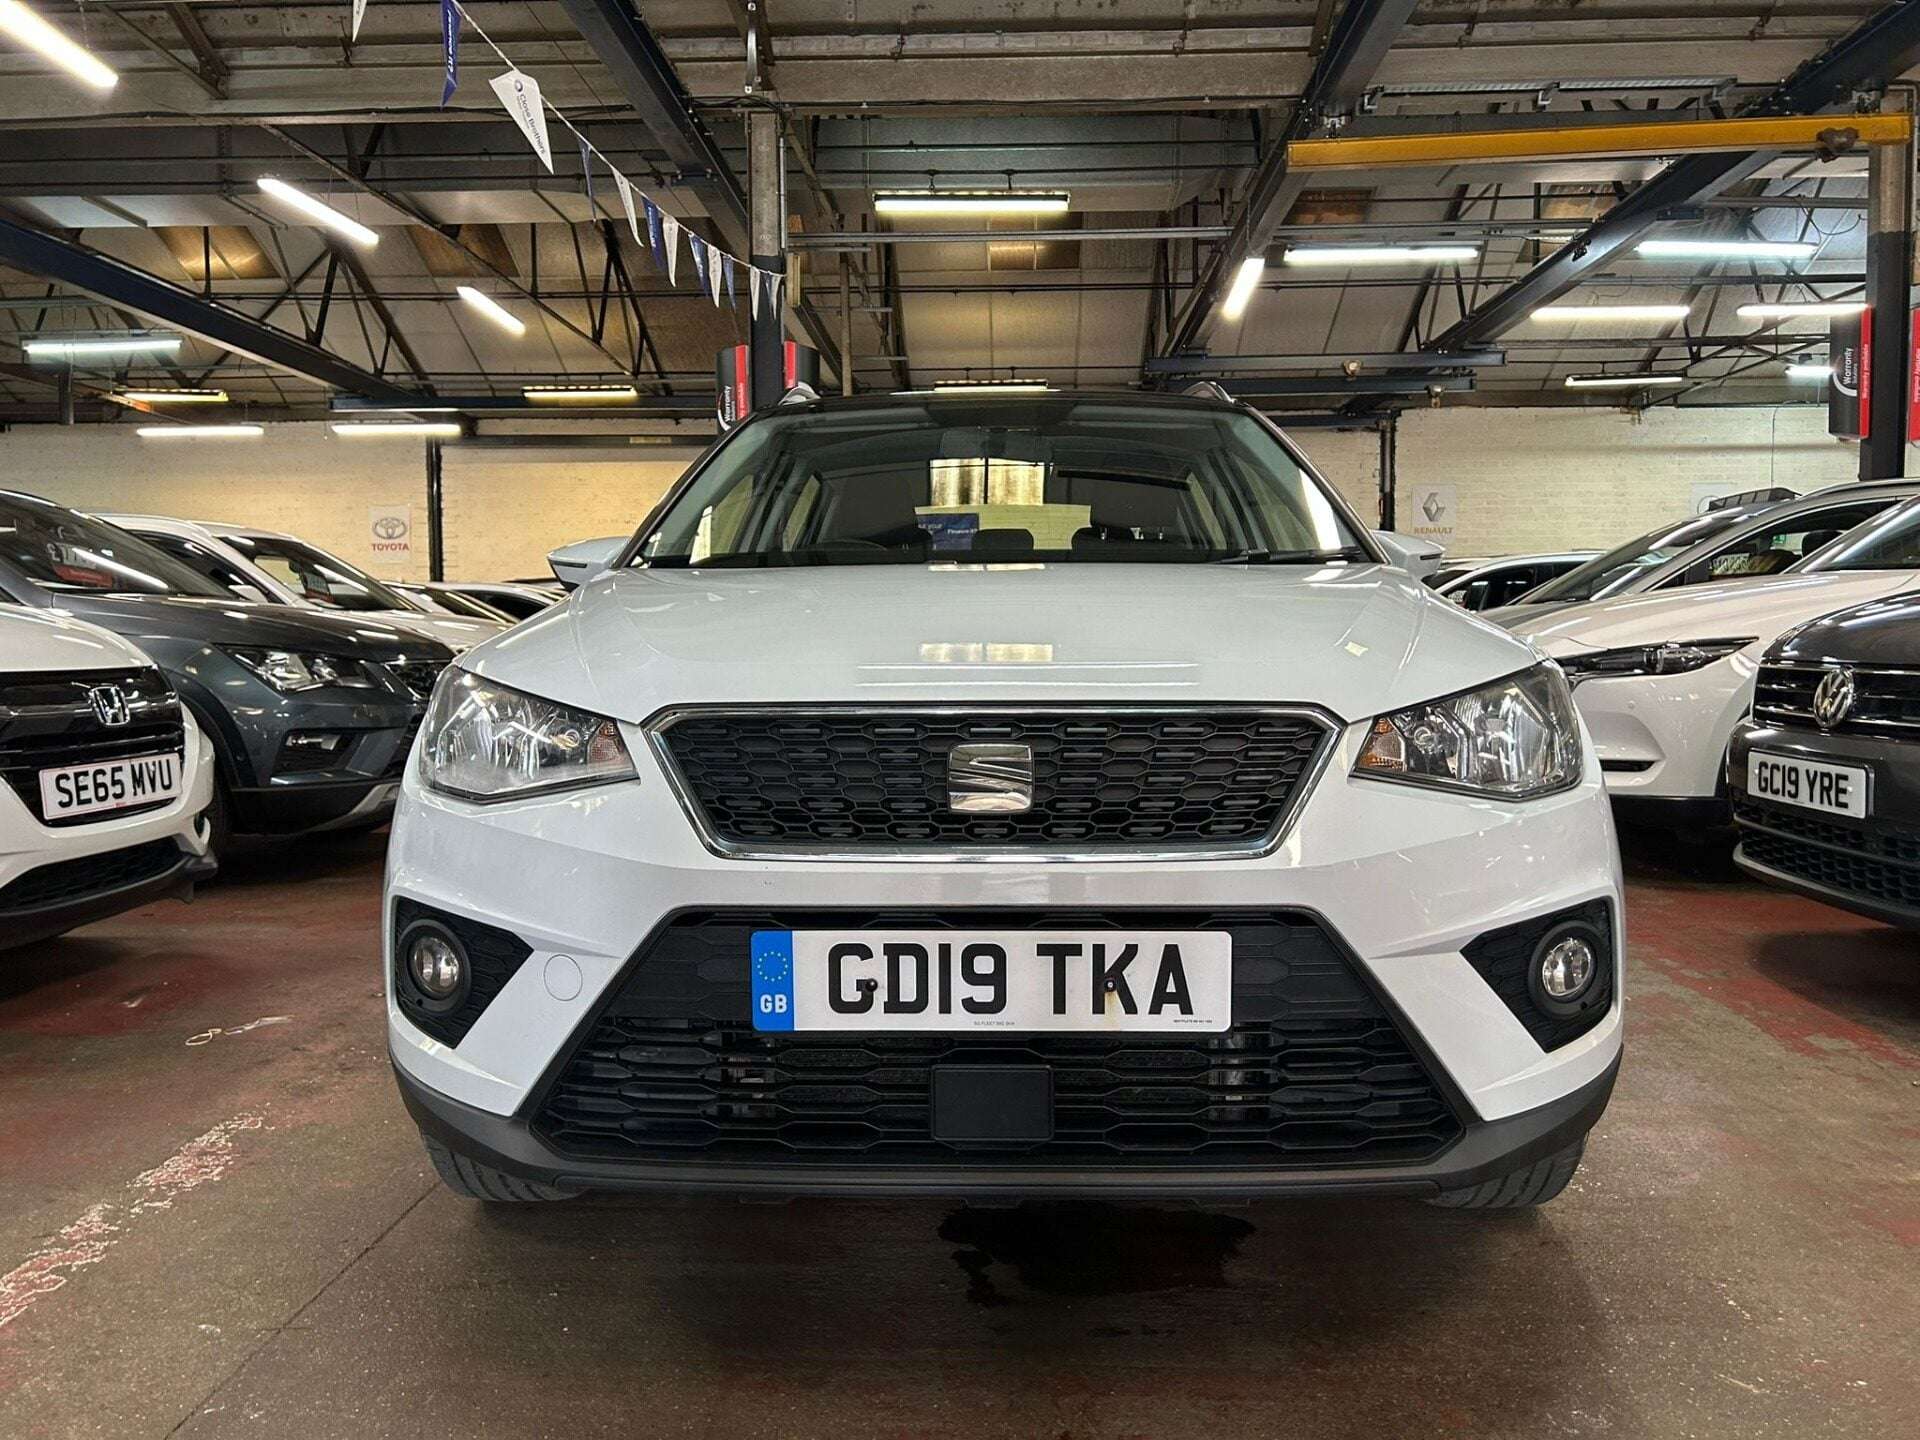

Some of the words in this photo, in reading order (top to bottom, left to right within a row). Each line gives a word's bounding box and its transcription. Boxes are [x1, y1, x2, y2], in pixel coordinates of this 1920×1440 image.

[519, 93, 532, 116] Close
[528, 118, 547, 154] Brothers
[1843, 347, 1854, 385] Warranty
[724, 386, 732, 421] Warranty
[372, 543, 409, 551] TOYOTA
[1415, 527, 1453, 535] RENAULT
[55, 765, 126, 808] SE65
[130, 758, 173, 797] MVU
[1757, 761, 1799, 800] GC19
[1805, 768, 1850, 809] YRE
[827, 942, 1008, 1015] GD19
[1036, 943, 1194, 1015] TKA
[760, 994, 787, 1013] GB
